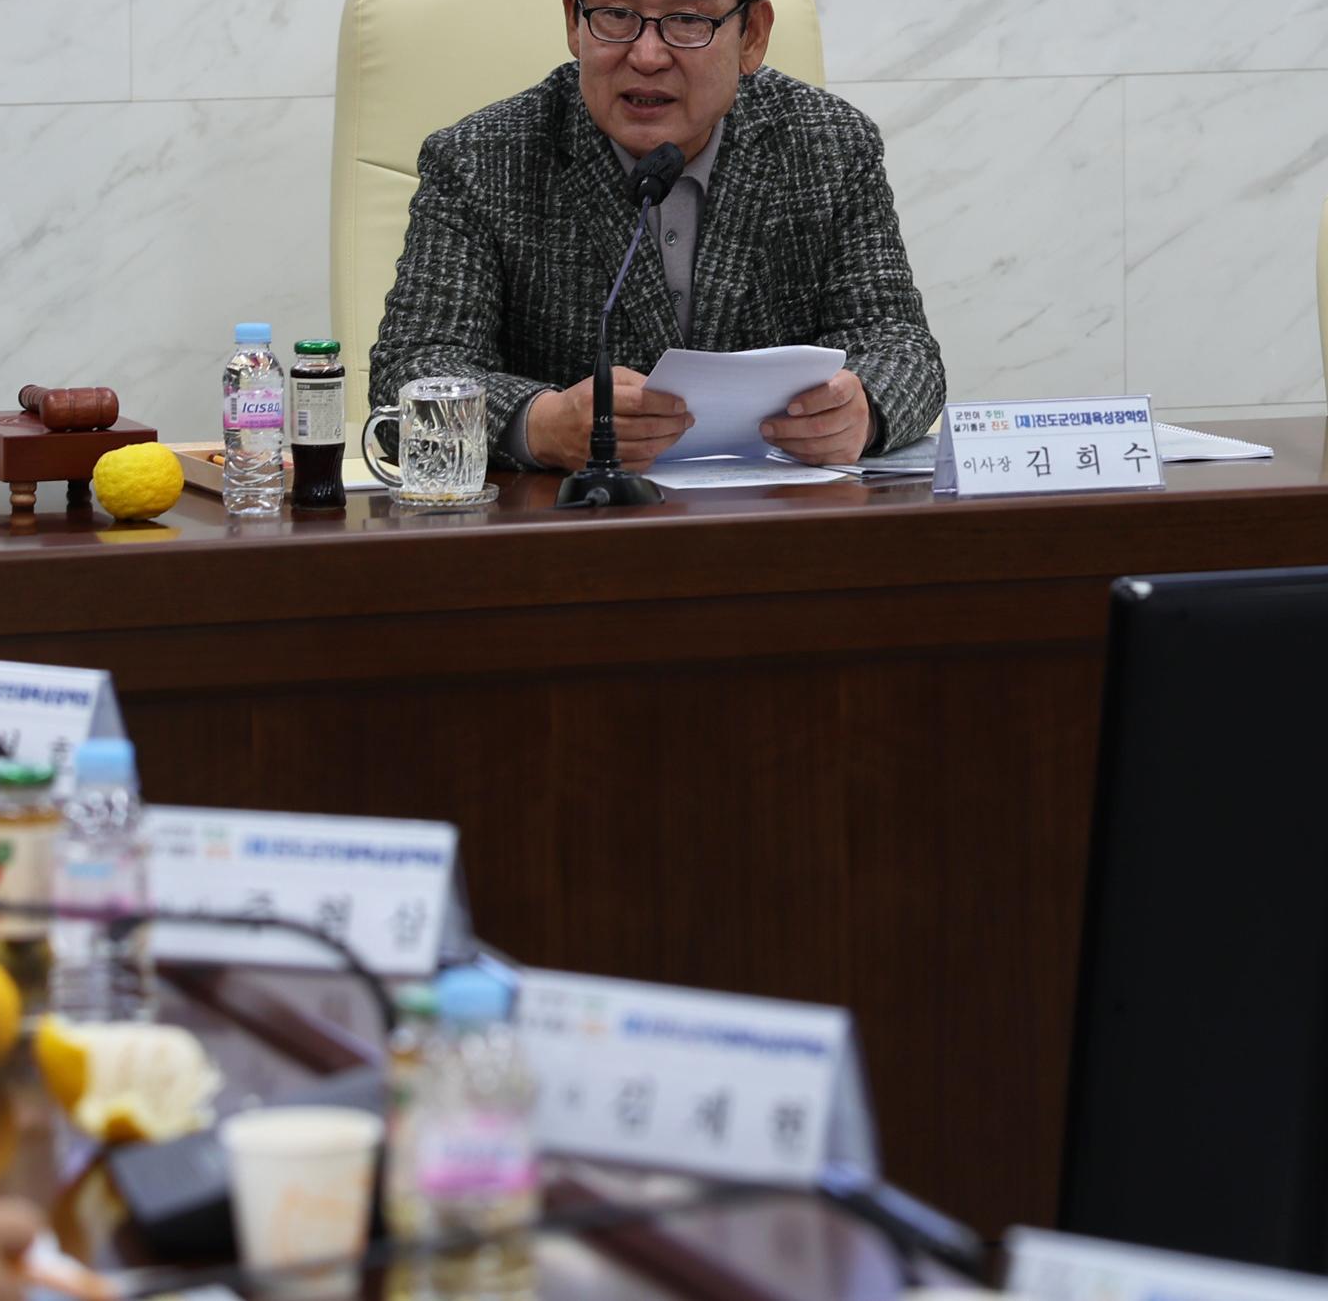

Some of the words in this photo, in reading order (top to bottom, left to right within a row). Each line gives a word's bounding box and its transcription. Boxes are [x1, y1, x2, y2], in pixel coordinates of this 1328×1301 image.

[955, 410, 981, 420] 군민이
[991, 420, 1010, 431] 진도
[963, 455, 1013, 474] 이사장
